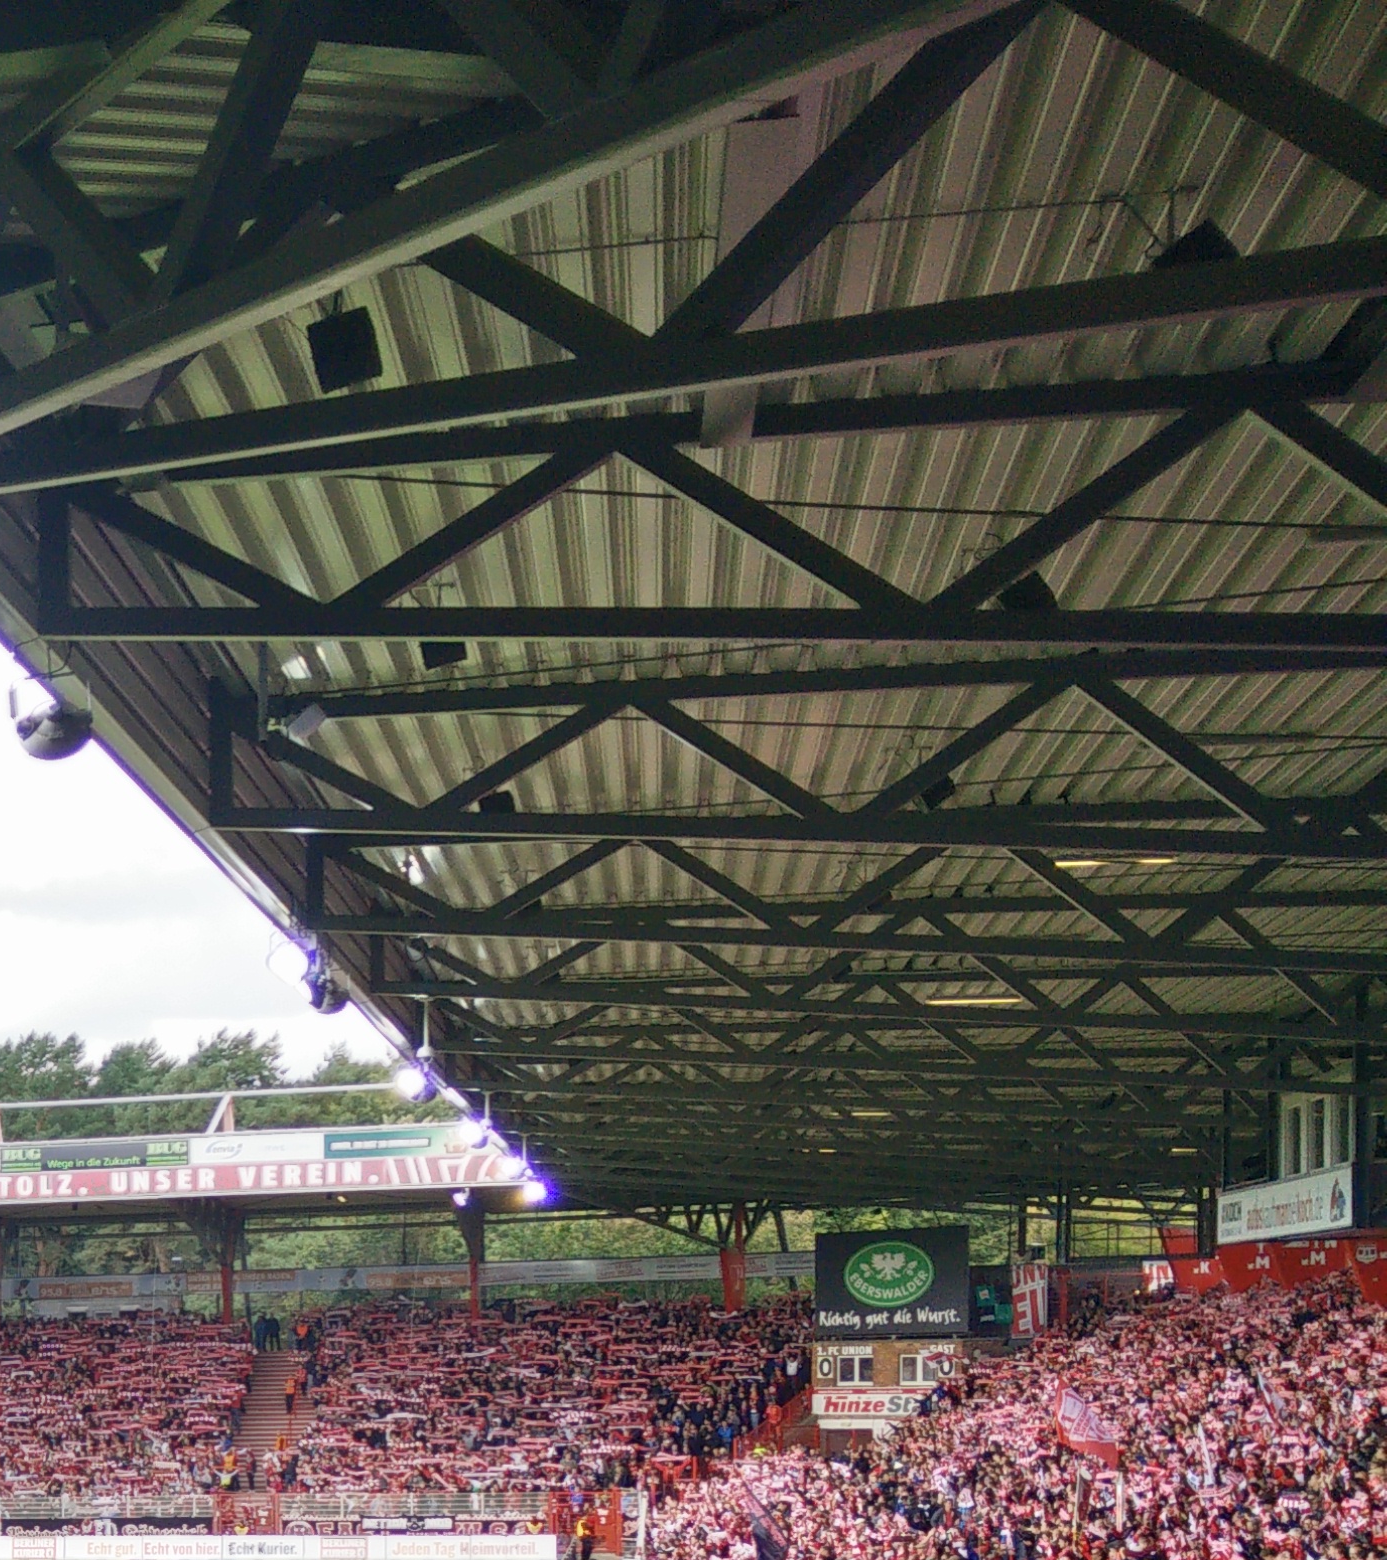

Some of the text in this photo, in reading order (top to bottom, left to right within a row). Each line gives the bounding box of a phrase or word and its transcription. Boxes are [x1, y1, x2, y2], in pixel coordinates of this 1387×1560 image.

[2, 1149, 42, 1161] BUG
[147, 1142, 188, 1154] BUG
[47, 1155, 141, 1170] Wege in die Zukunft
[110, 1167, 215, 1193] UNSER
[238, 1161, 379, 1188] VEREIN.
[849, 1269, 930, 1300] EBERSWALDER
[819, 1309, 861, 1330] Richtig
[866, 1310, 891, 1329] gut
[893, 1307, 913, 1323] die
[828, 1347, 840, 1356] FC
[841, 1346, 873, 1356] UNION
[819, 1358, 833, 1378] 0
[87, 1542, 297, 1557] Echt gut. Echt von hier. Echt Kurier.
[392, 1542, 538, 1558] Jeden Tag Heimvorteil.
